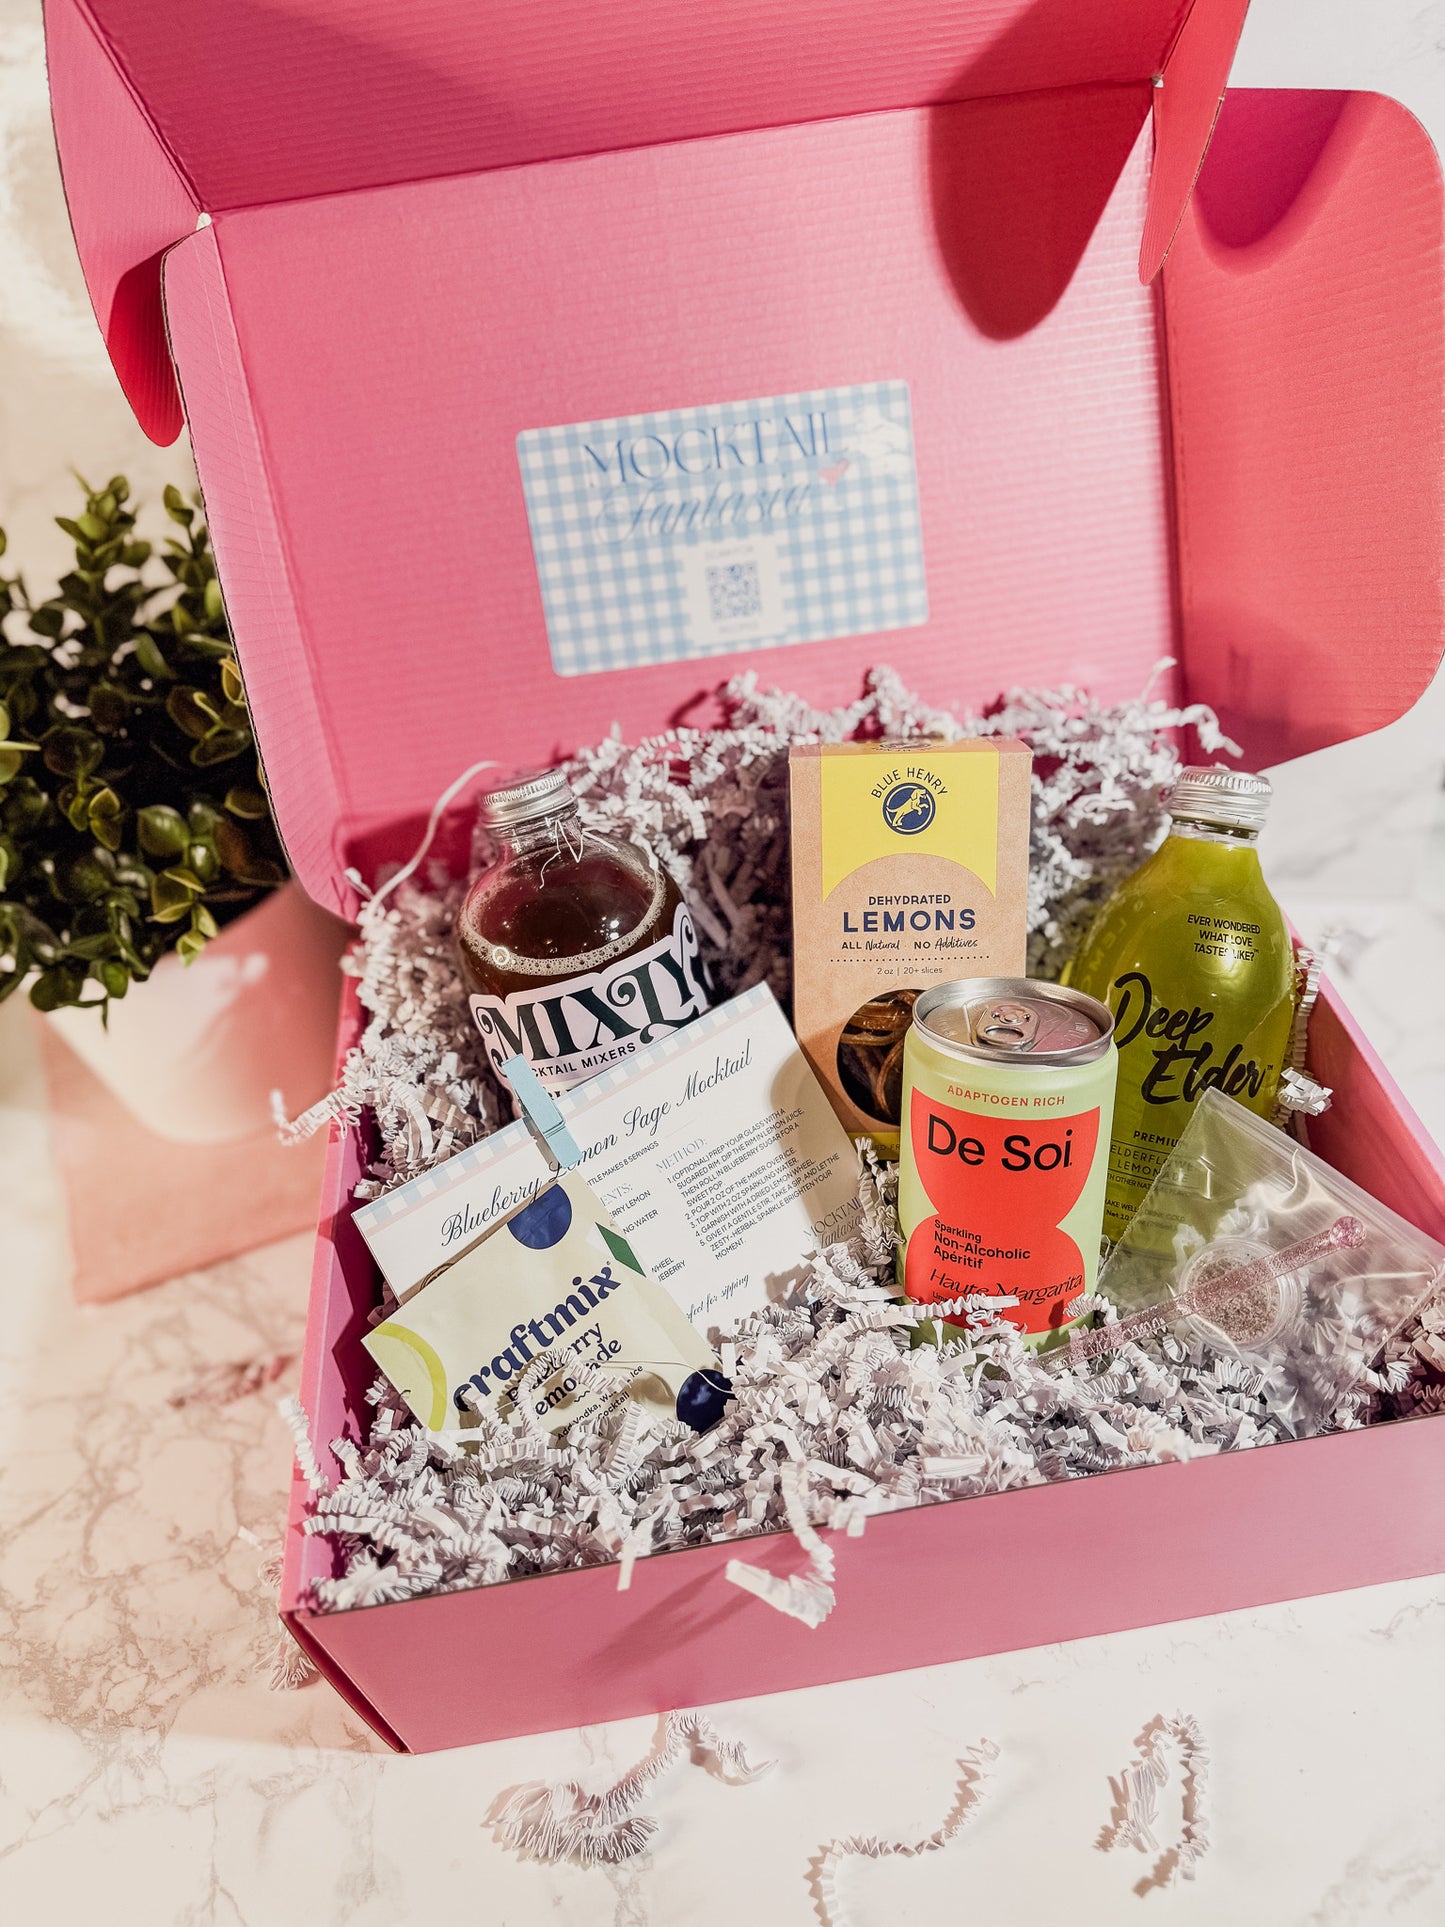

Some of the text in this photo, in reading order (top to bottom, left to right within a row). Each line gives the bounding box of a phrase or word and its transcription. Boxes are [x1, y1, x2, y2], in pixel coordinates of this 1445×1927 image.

[584, 411, 846, 487] MOCKTAIL
[871, 767, 948, 799] BLUE HENRY
[868, 894, 951, 906] DEHYDRATED
[843, 908, 976, 933] LEMONS
[1187, 914, 1260, 935] EVER WONDERED
[841, 936, 978, 951] ALL Natural NO Additives
[1200, 929, 1253, 947] WHAT LOVE
[876, 967, 883, 975] 2
[903, 966, 920, 975] 20+
[921, 965, 943, 974] slices
[476, 914, 700, 1076] MIXLY
[1114, 972, 1214, 1050] Deep
[581, 1043, 636, 1069] MIXERS
[1141, 1042, 1266, 1105] Elder
[947, 1084, 1065, 1107] ADAPTOGEN RICH
[441, 1176, 543, 1248] Blueberry
[545, 1134, 618, 1182] Lmon
[623, 1100, 671, 1137] Sage
[676, 1038, 753, 1108] Mocktail
[928, 1113, 986, 1166] De
[586, 1173, 603, 1186] TTLE
[601, 1161, 624, 1178] MAKES
[627, 1140, 659, 1163] SERVINGS
[722, 1145, 759, 1173] BLUEBERRY
[758, 1132, 782, 1151] SUGAR
[676, 1166, 709, 1190] SUGARED
[740, 1170, 776, 1197] SPARKLING
[624, 1189, 651, 1209] LEMON
[783, 1180, 815, 1204] BRIGHTEN
[633, 1209, 658, 1227] WATER
[700, 1210, 731, 1234] GARNISH
[934, 1219, 982, 1244] Sparkling
[933, 1245, 984, 1270] Apéritif
[934, 1230, 1031, 1260] Non-Alcoholic
[929, 1268, 1083, 1306] Haute Margarita
[630, 1366, 643, 1378] Ice
